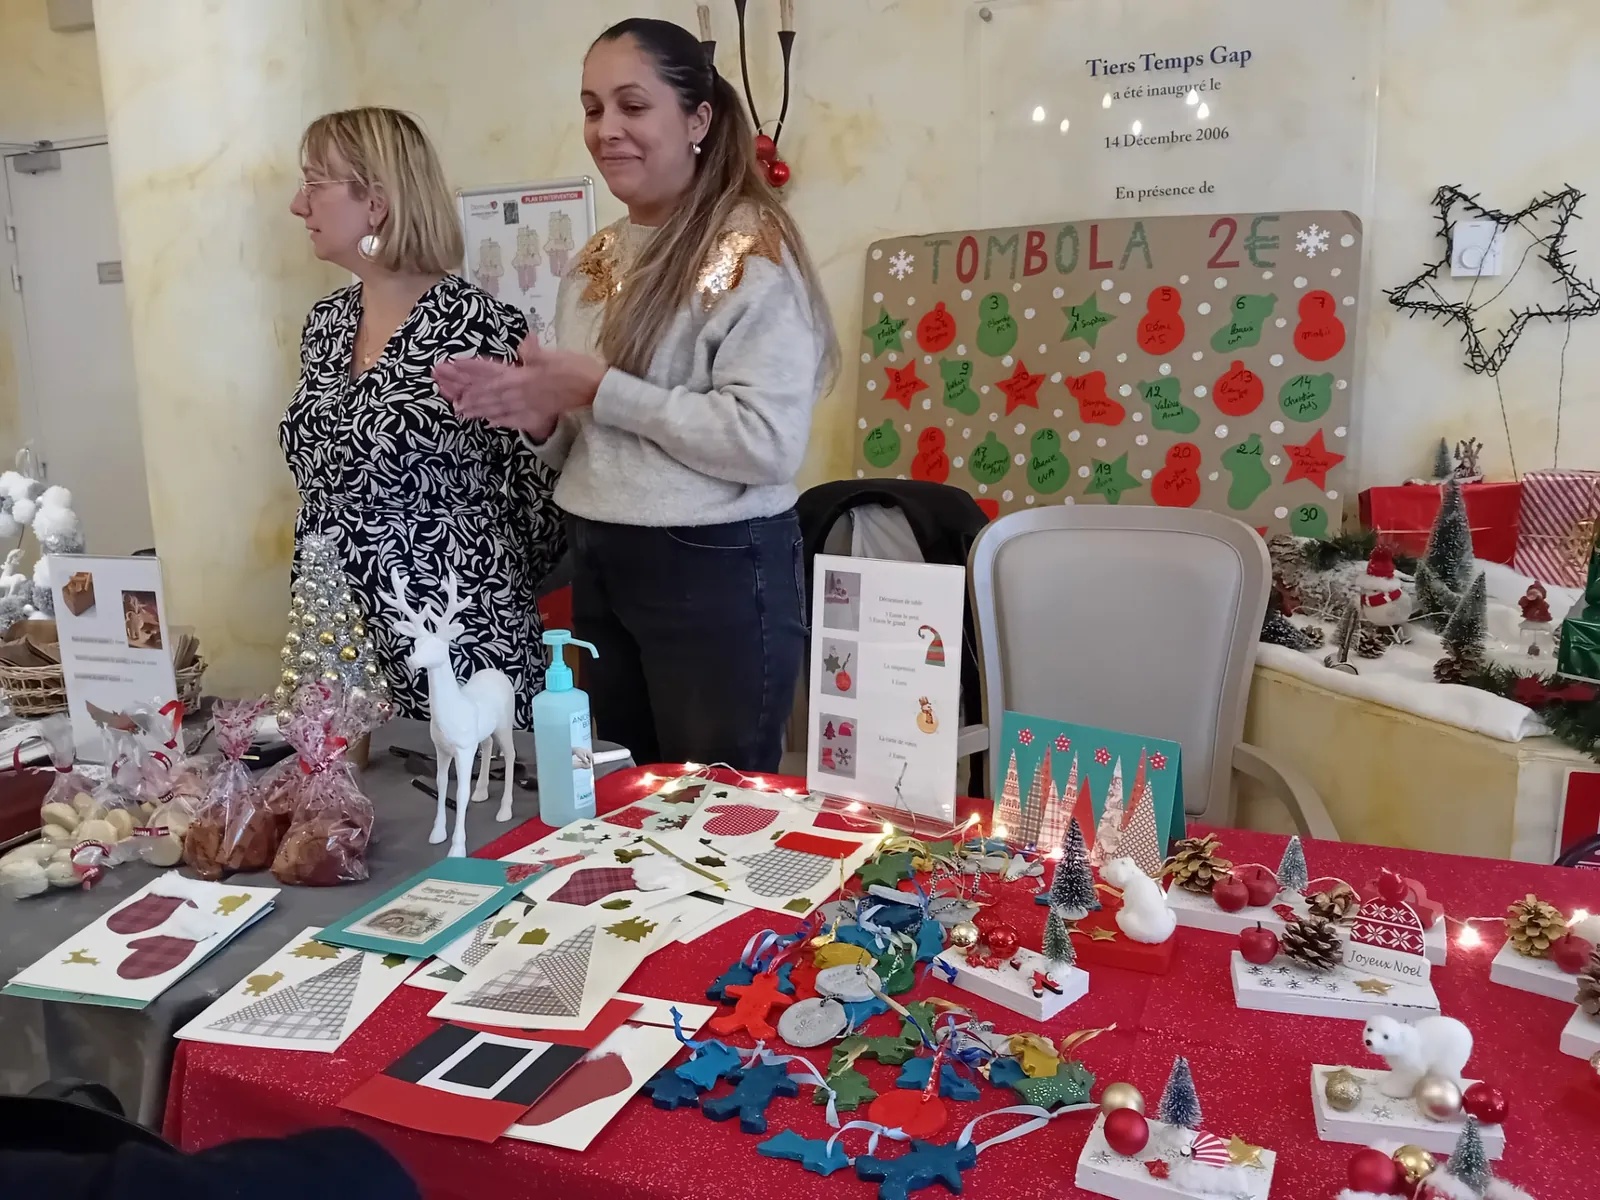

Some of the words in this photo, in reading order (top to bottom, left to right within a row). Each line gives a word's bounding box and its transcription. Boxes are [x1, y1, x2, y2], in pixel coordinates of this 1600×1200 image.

[1086, 58, 1136, 77] Tiers
[1139, 52, 1204, 73] Temps
[1209, 45, 1252, 67] Gap
[1113, 92, 1120, 100] a
[1123, 86, 1143, 99] été
[1147, 79, 1206, 98] inauguré
[1210, 78, 1222, 90] le
[1104, 136, 1120, 149] 14
[1123, 130, 1192, 147] Décembre
[1195, 126, 1229, 141] 2006
[1115, 186, 1134, 200] En
[1137, 182, 1195, 202] présence
[1198, 181, 1215, 193] de
[924, 221, 1153, 285] TOMBOLA
[1160, 288, 1172, 302] 5
[1312, 296, 1325, 308] 7
[989, 295, 999, 310] 3
[1236, 295, 1247, 310] 6
[1071, 306, 1080, 321] 4
[894, 371, 902, 383] 8
[1231, 370, 1253, 383] 13
[1292, 375, 1312, 390] 14
[1072, 378, 1087, 391] 11
[1145, 385, 1162, 398] 12
[867, 428, 882, 441] 15
[922, 431, 937, 442] 16
[1037, 429, 1054, 440] 18
[974, 446, 987, 461] 17
[1172, 446, 1191, 459] 20
[1236, 443, 1261, 456] 21
[1293, 446, 1316, 459] 22
[1095, 463, 1111, 475] 19
[1300, 507, 1318, 522] 30
[1348, 950, 1393, 969] Joyeux
[1393, 960, 1422, 977] Noel
